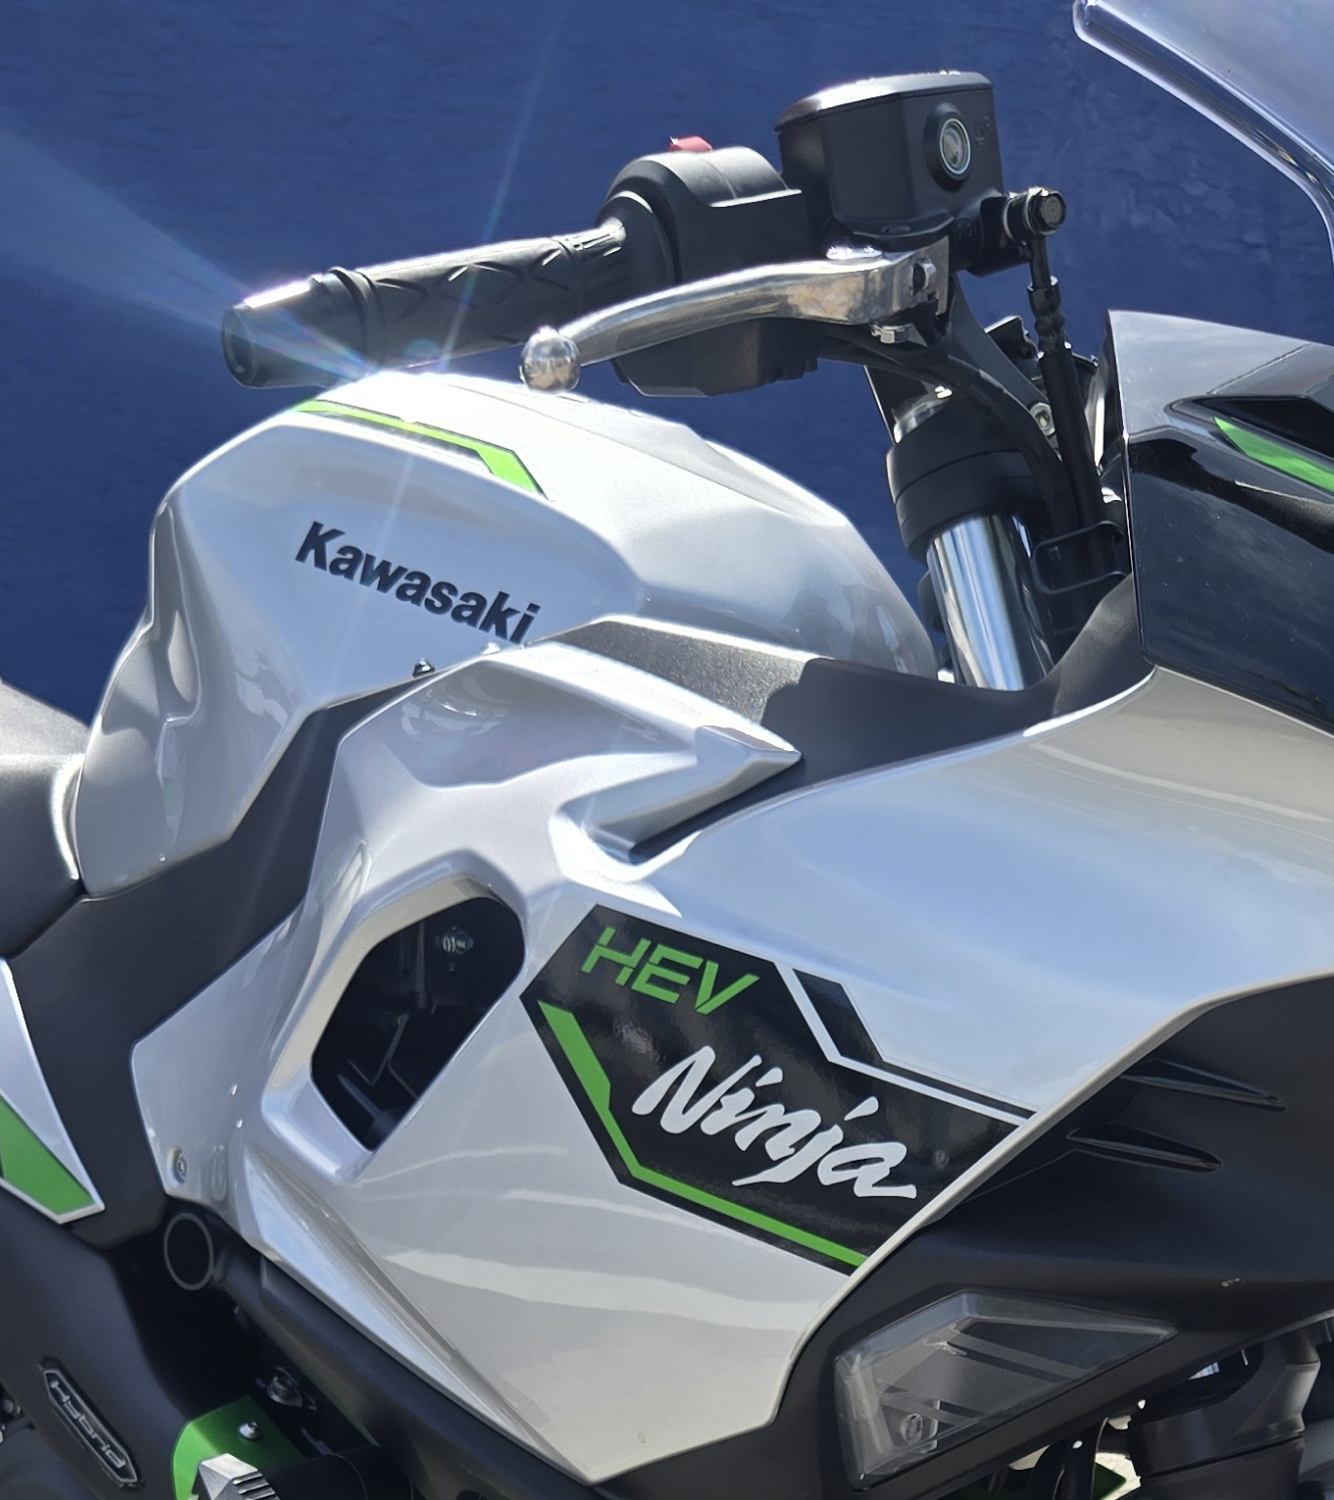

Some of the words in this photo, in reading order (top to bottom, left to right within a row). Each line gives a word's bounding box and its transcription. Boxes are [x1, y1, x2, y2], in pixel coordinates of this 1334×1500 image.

[295, 521, 541, 645] Kawasaki
[581, 926, 760, 1015] HEV
[631, 1045, 917, 1199] Ninja
[50, 1380, 126, 1469] Hybrid
